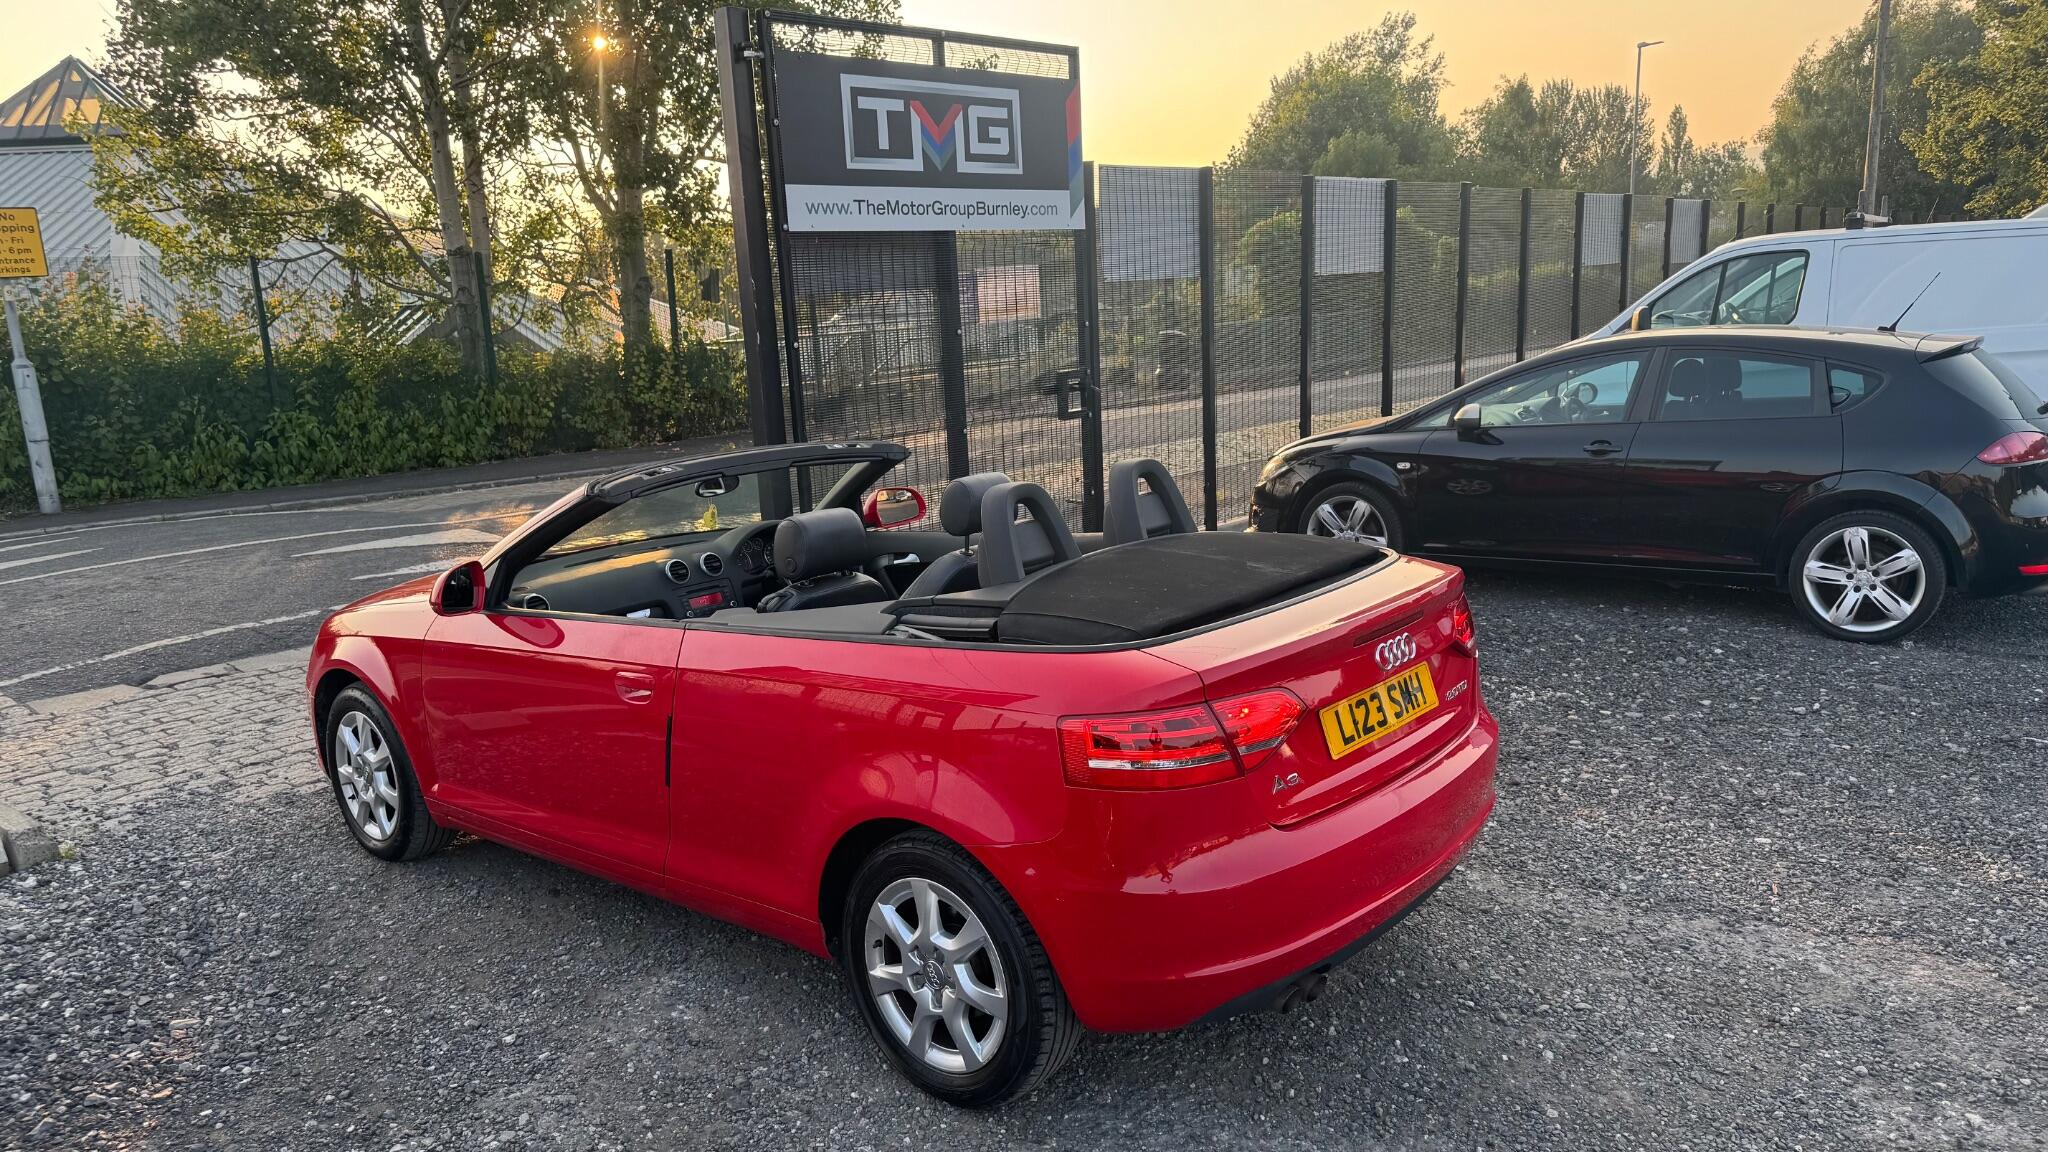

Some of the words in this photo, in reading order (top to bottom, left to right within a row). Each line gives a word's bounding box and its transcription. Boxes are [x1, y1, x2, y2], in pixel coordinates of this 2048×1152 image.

[857, 95, 1010, 172] TMG
[805, 199, 1059, 219] www.TheMotorGroupBurnley.com
[0, 212, 15, 221] No
[0, 224, 35, 233] pping
[11, 236, 24, 244] Fri
[17, 247, 32, 255] pm
[0, 266, 31, 274] rkings
[1386, 671, 1427, 720] SMH
[1272, 772, 1300, 796] A3
